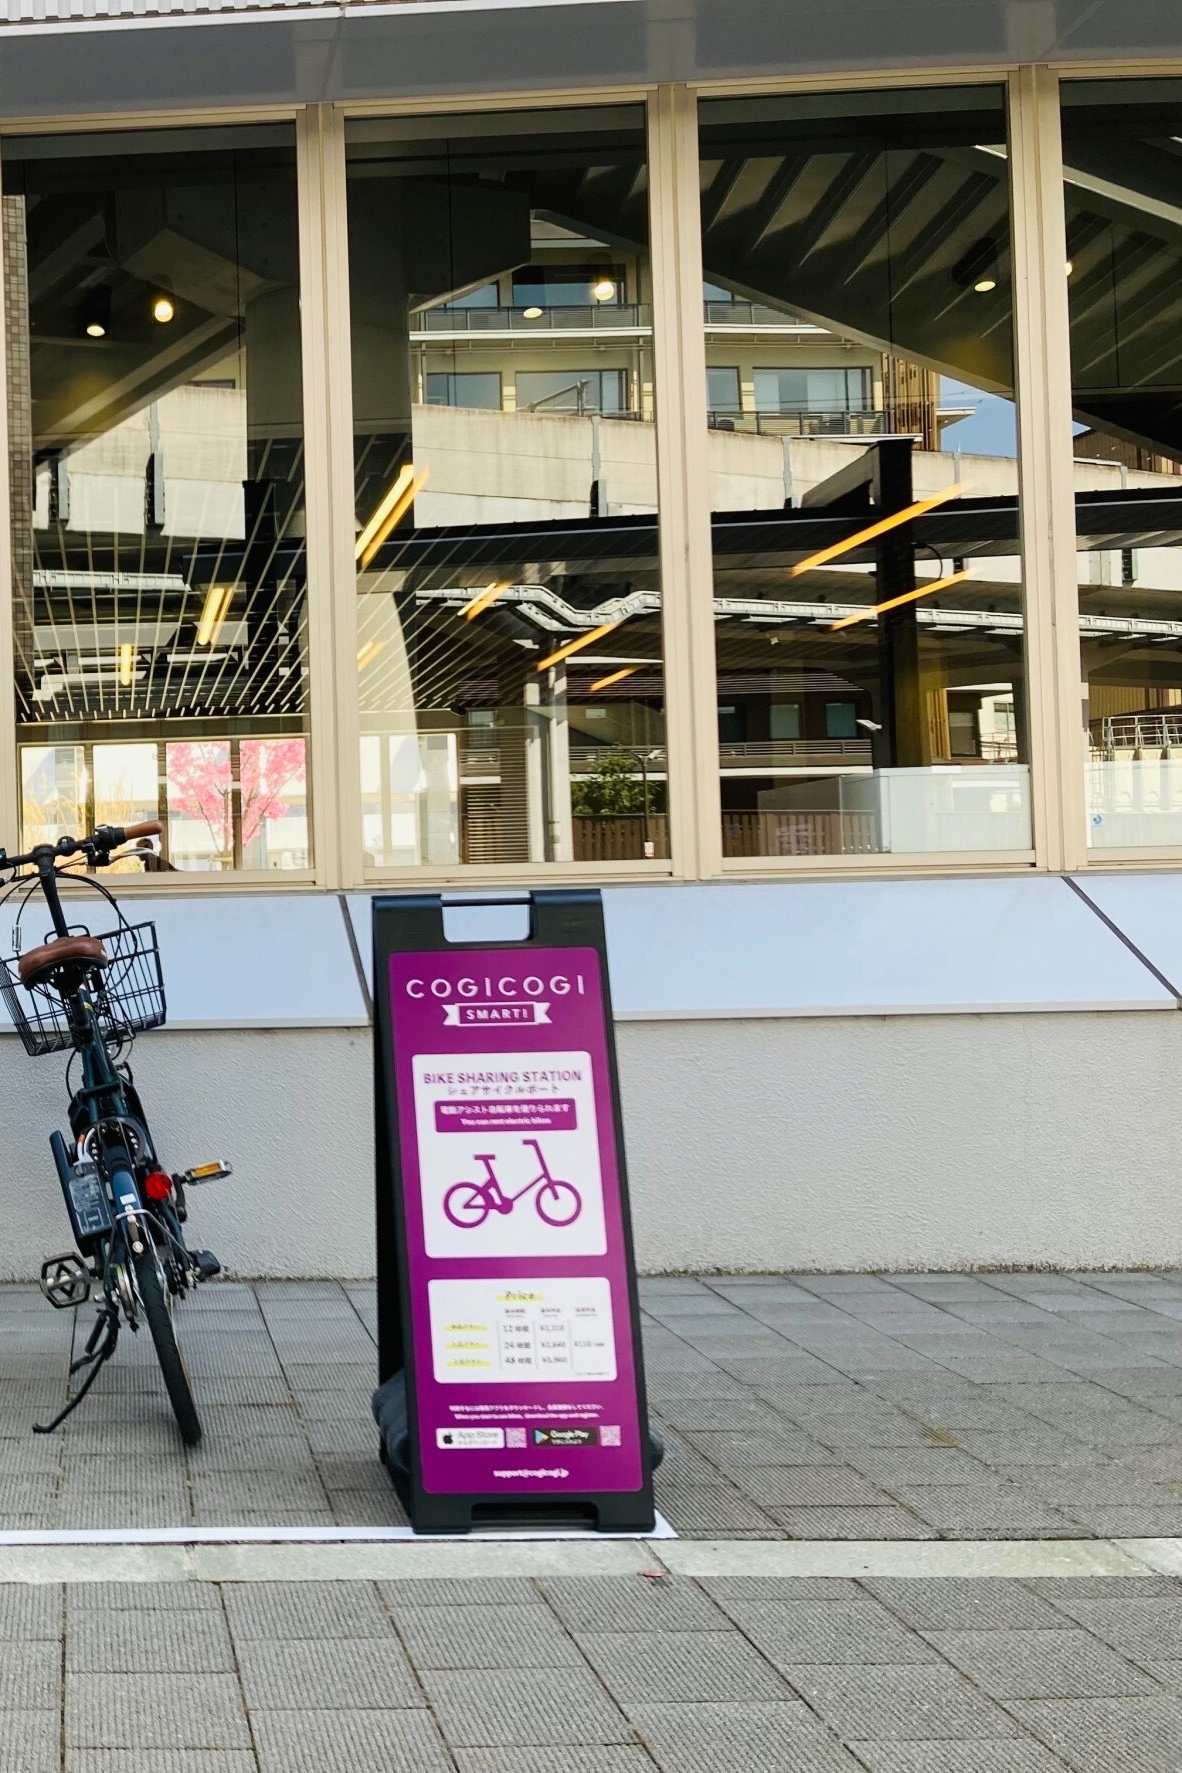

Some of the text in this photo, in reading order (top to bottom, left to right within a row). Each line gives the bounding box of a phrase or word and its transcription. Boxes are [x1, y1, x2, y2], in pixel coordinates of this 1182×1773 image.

[406, 974, 585, 998] COGICOGI
[423, 1070, 582, 1084] BIKE SHARING STATION
[458, 1430, 499, 1440] App Store
[549, 1429, 590, 1440] Google Play
